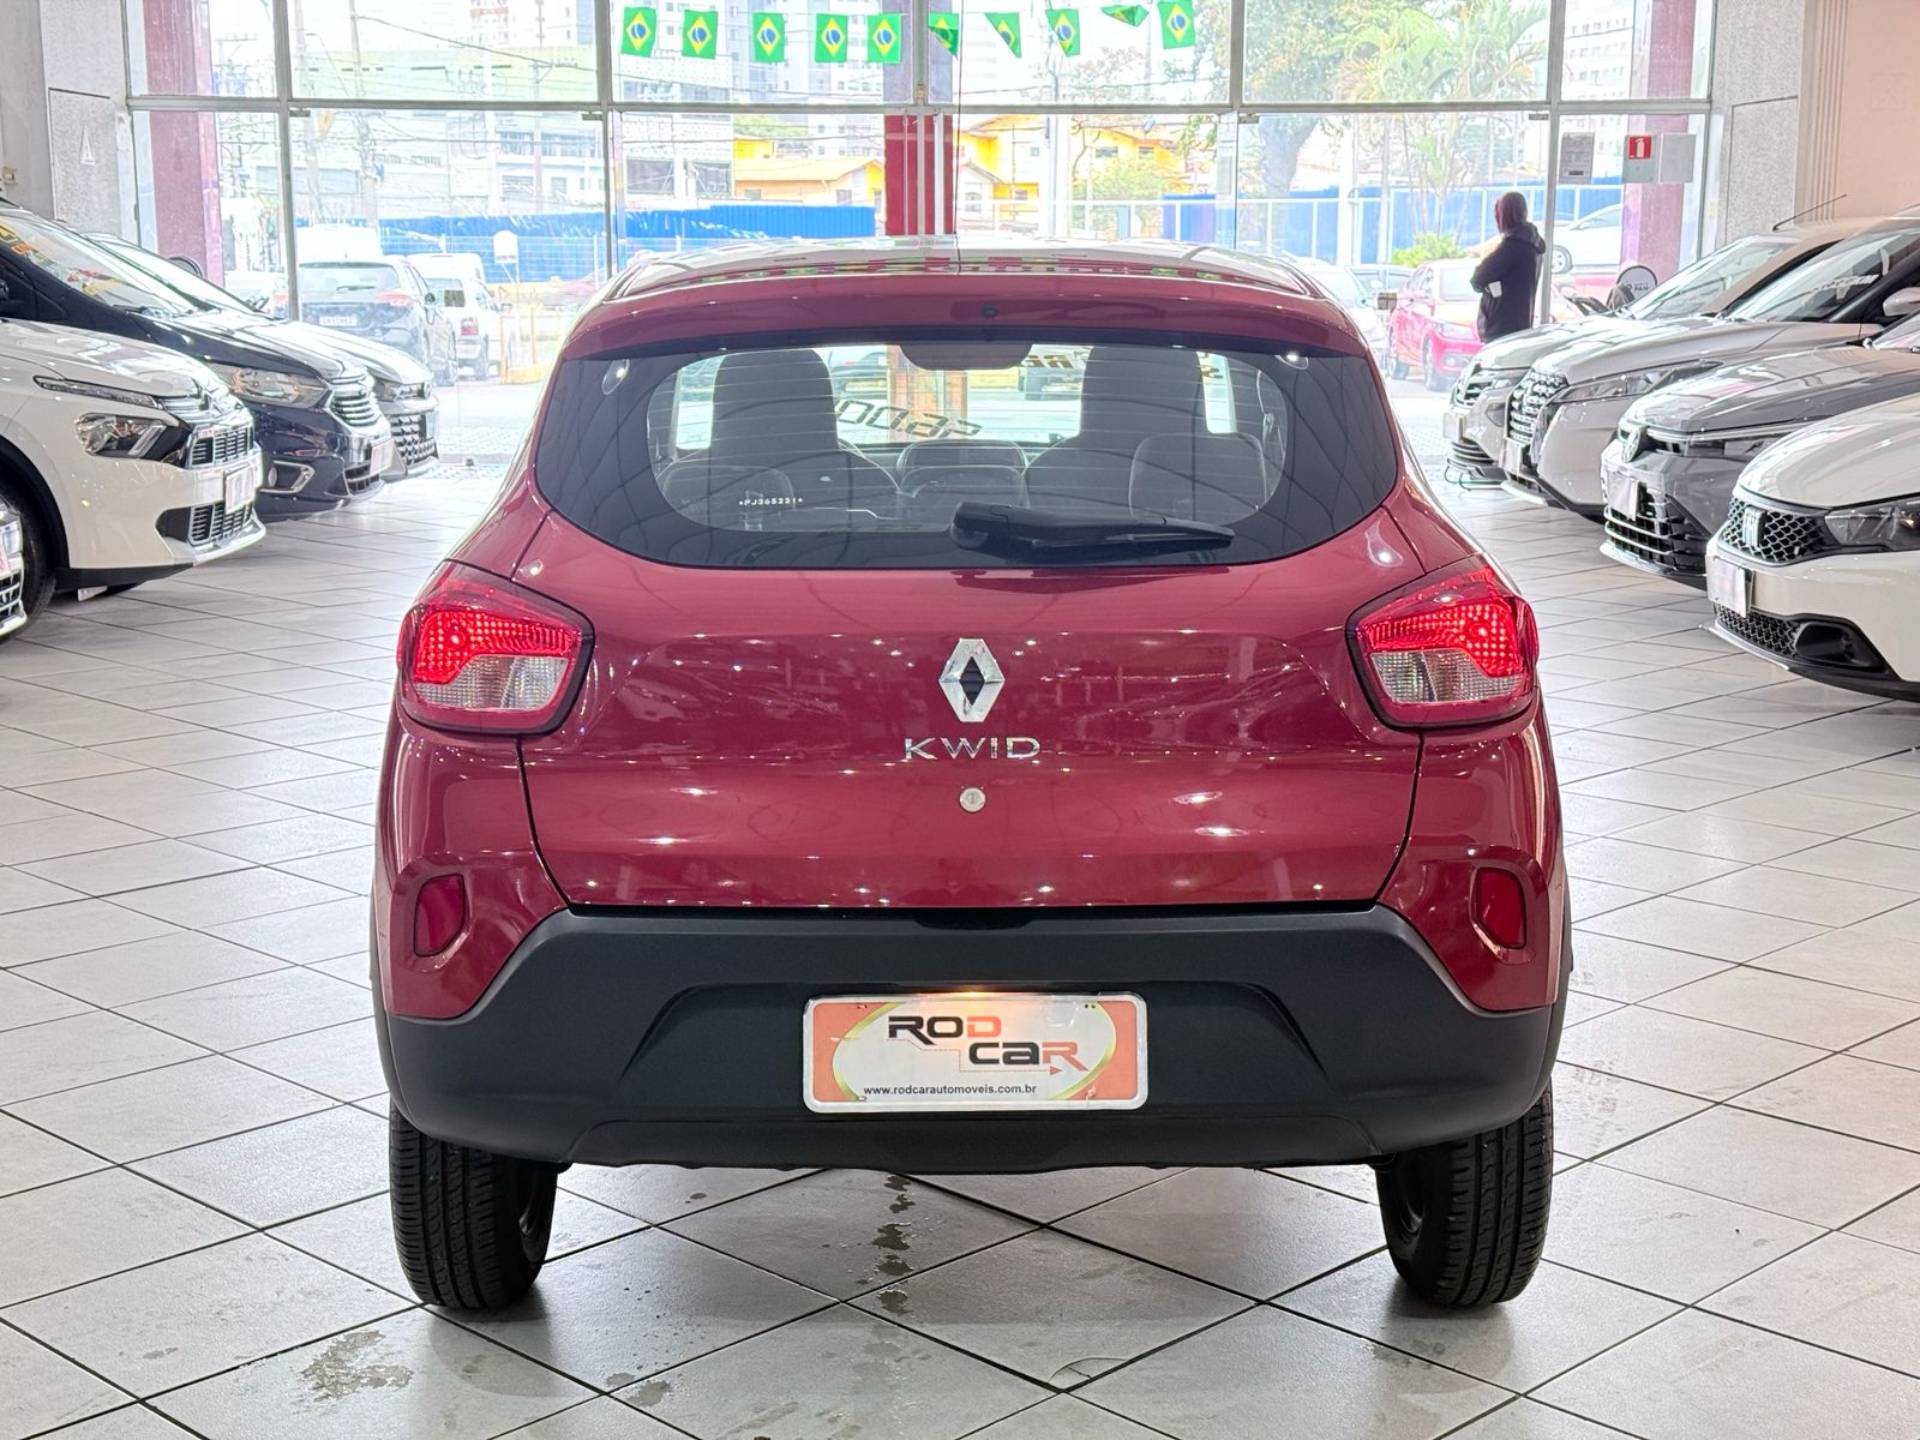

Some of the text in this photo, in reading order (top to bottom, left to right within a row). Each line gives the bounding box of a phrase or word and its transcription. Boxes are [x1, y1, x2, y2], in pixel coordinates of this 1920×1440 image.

[905, 738, 1040, 759] KWID
[889, 1016, 1002, 1045] ROD
[864, 1085, 1036, 1096] www.rodcarautomoveis.com.br
